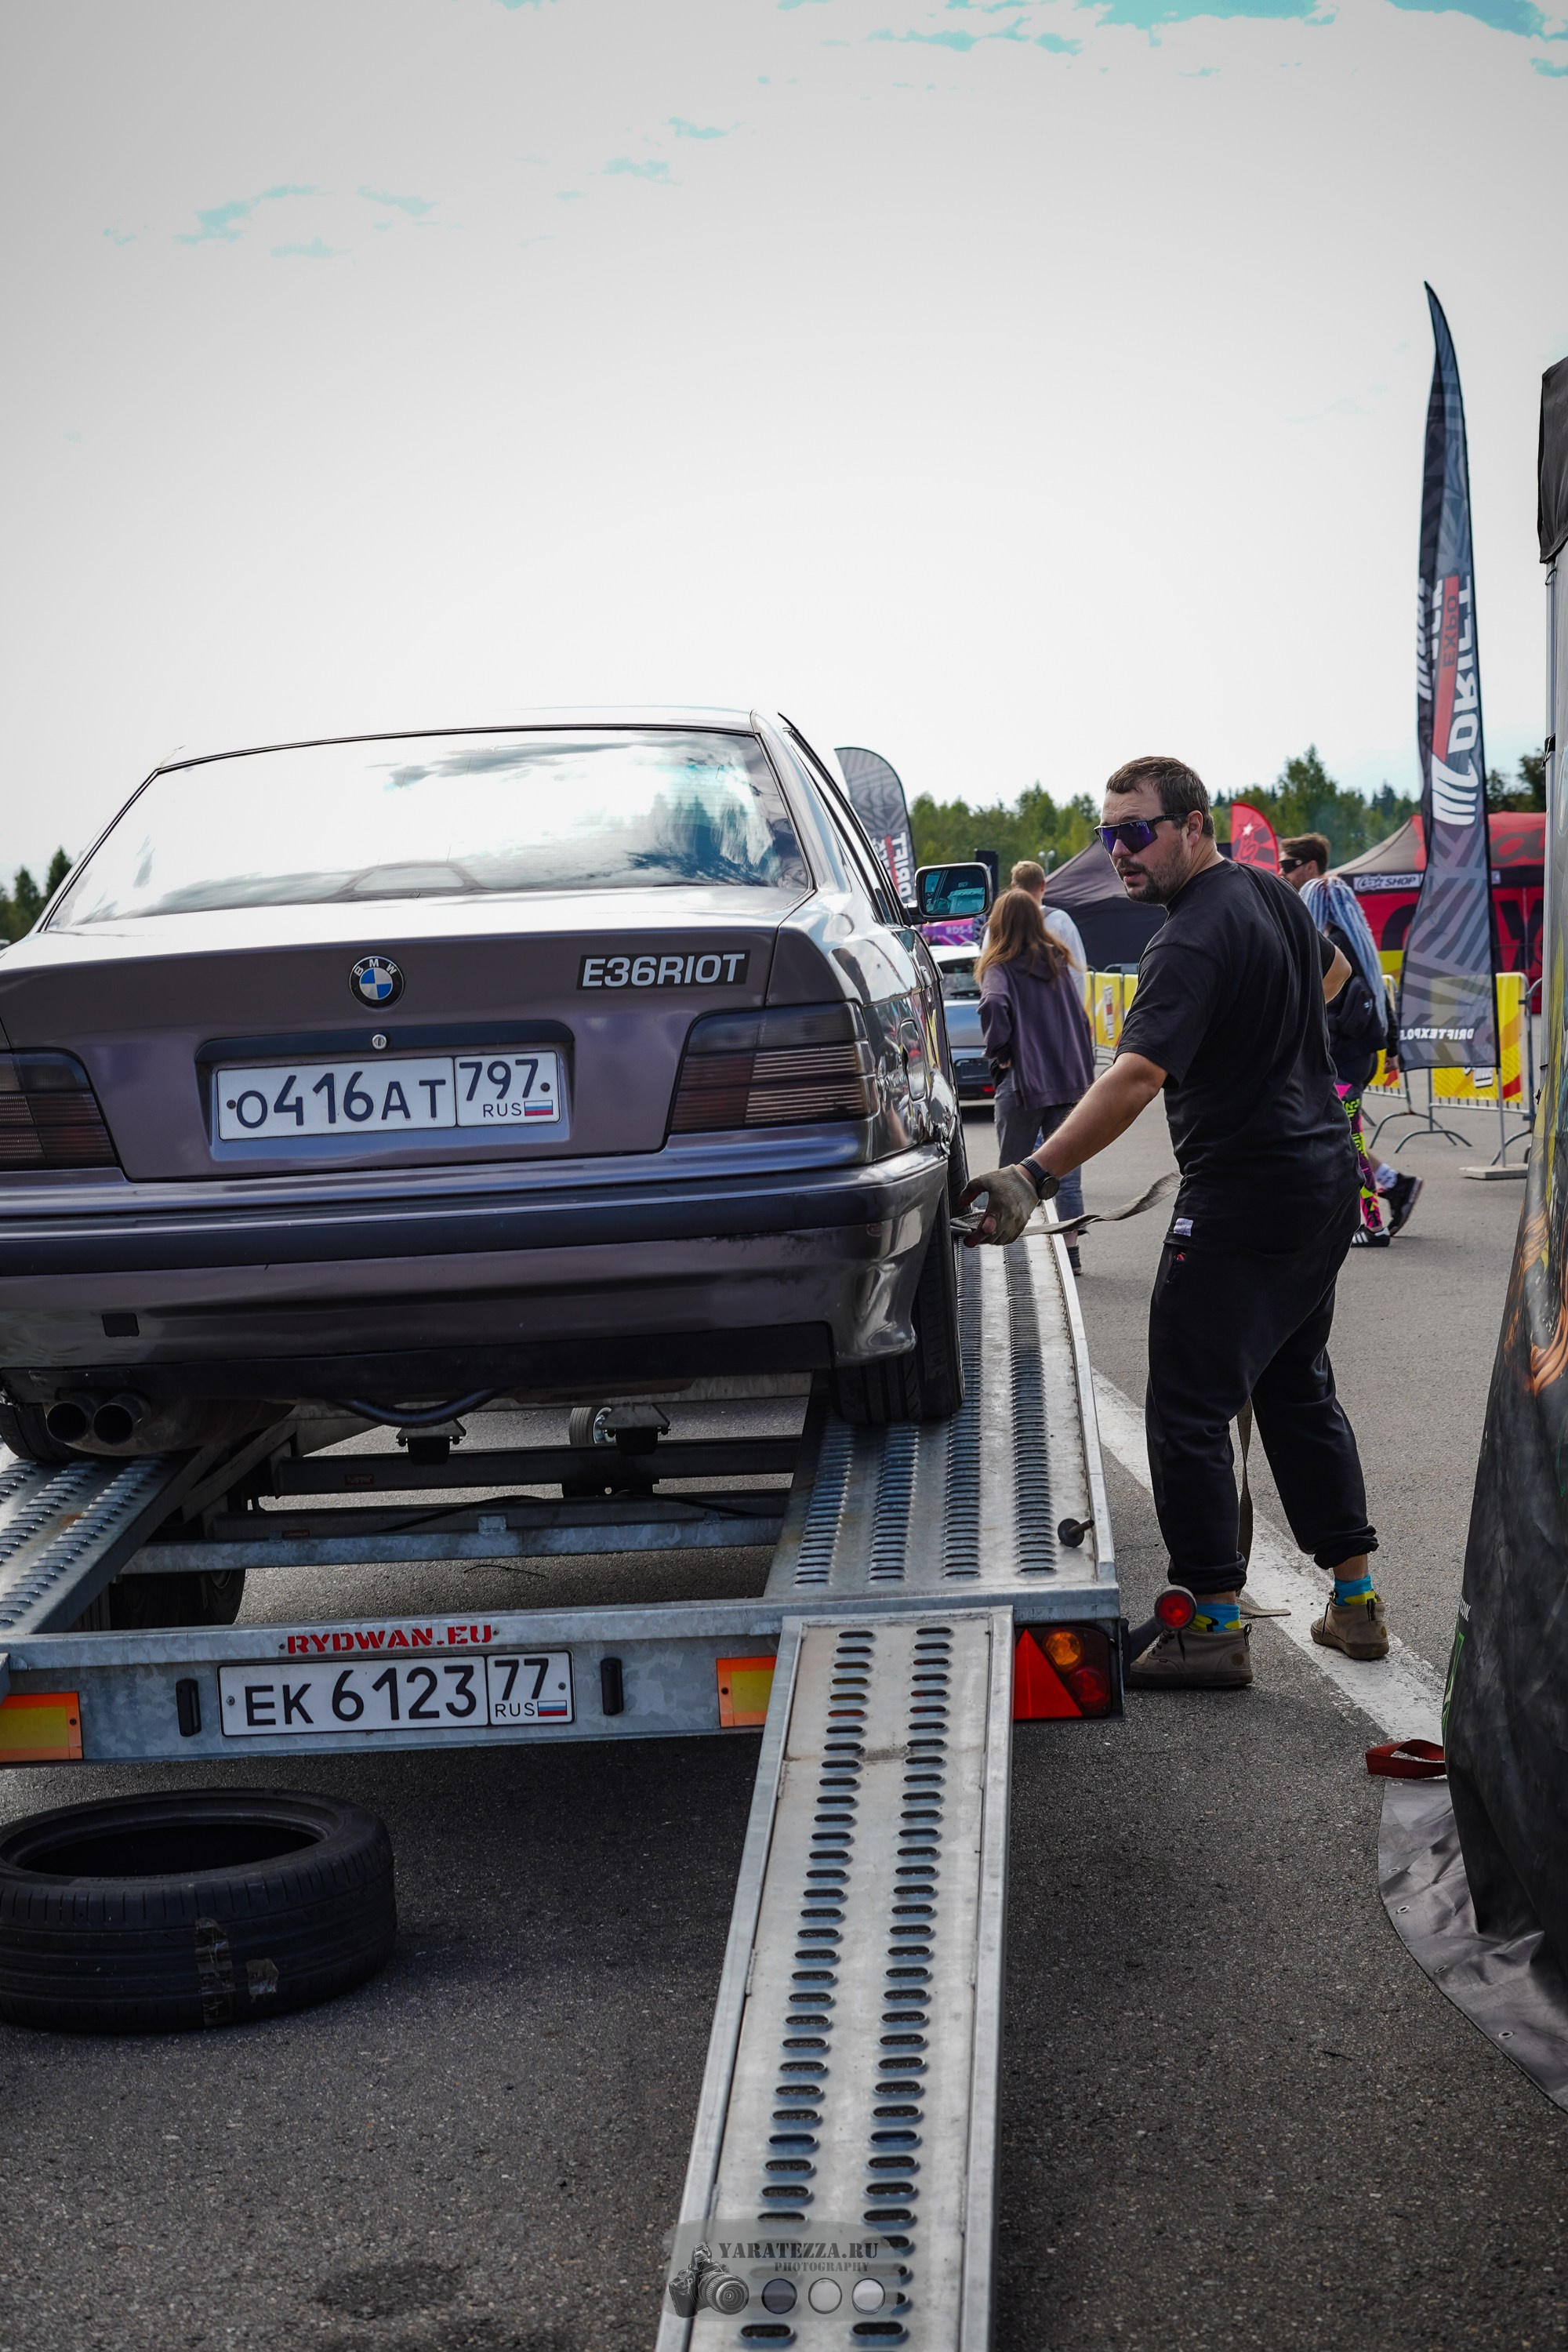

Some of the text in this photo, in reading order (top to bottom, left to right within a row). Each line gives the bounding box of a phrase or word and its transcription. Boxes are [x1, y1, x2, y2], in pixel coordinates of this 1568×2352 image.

[1385, 877, 1416, 886] SHOP
[354, 958, 397, 977] BMW
[582, 953, 744, 988] E36RIOT
[459, 1058, 539, 1102] 797
[483, 1103, 521, 1117] RUS
[287, 1624, 492, 1654] RYDWAN.EU
[495, 1658, 549, 1700] 77
[495, 1702, 535, 1717] RUS
